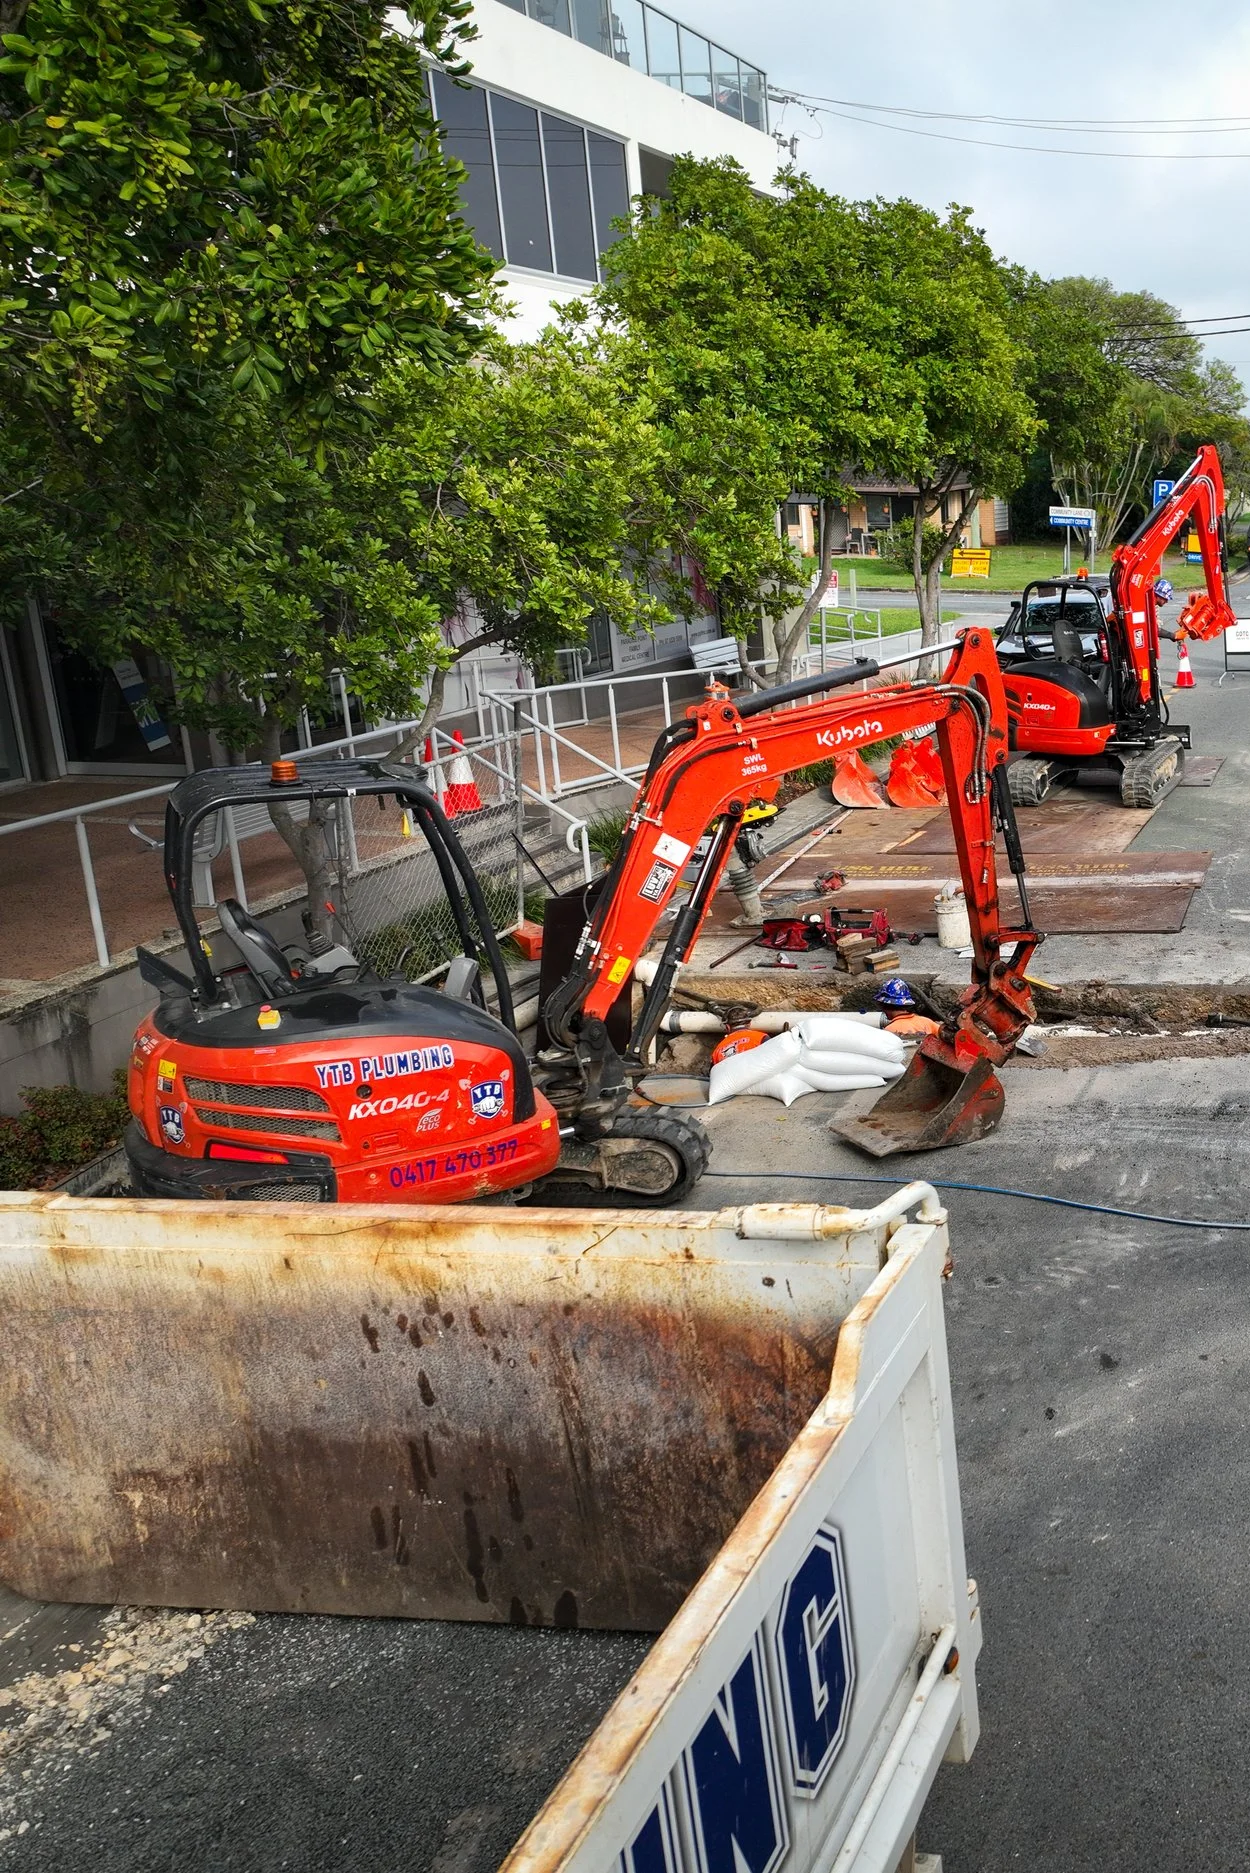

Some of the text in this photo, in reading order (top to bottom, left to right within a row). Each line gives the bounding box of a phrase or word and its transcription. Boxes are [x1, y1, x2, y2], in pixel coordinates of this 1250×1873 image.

[1158, 484, 1168, 496] P
[1161, 509, 1184, 536] Kubota
[1023, 702, 1056, 711] KX040-4
[816, 719, 883, 747] Kubota
[743, 753, 765, 765] SWL
[741, 763, 767, 777] 365kg
[315, 1044, 454, 1088] YTB PLUMBING
[473, 1084, 500, 1099] YTB
[348, 1088, 450, 1120] KX040-4
[161, 1110, 180, 1123] YTB
[422, 1114, 441, 1124] eco
[416, 1122, 440, 1133] PLUS
[389, 1139, 519, 1188] 0417 470 377
